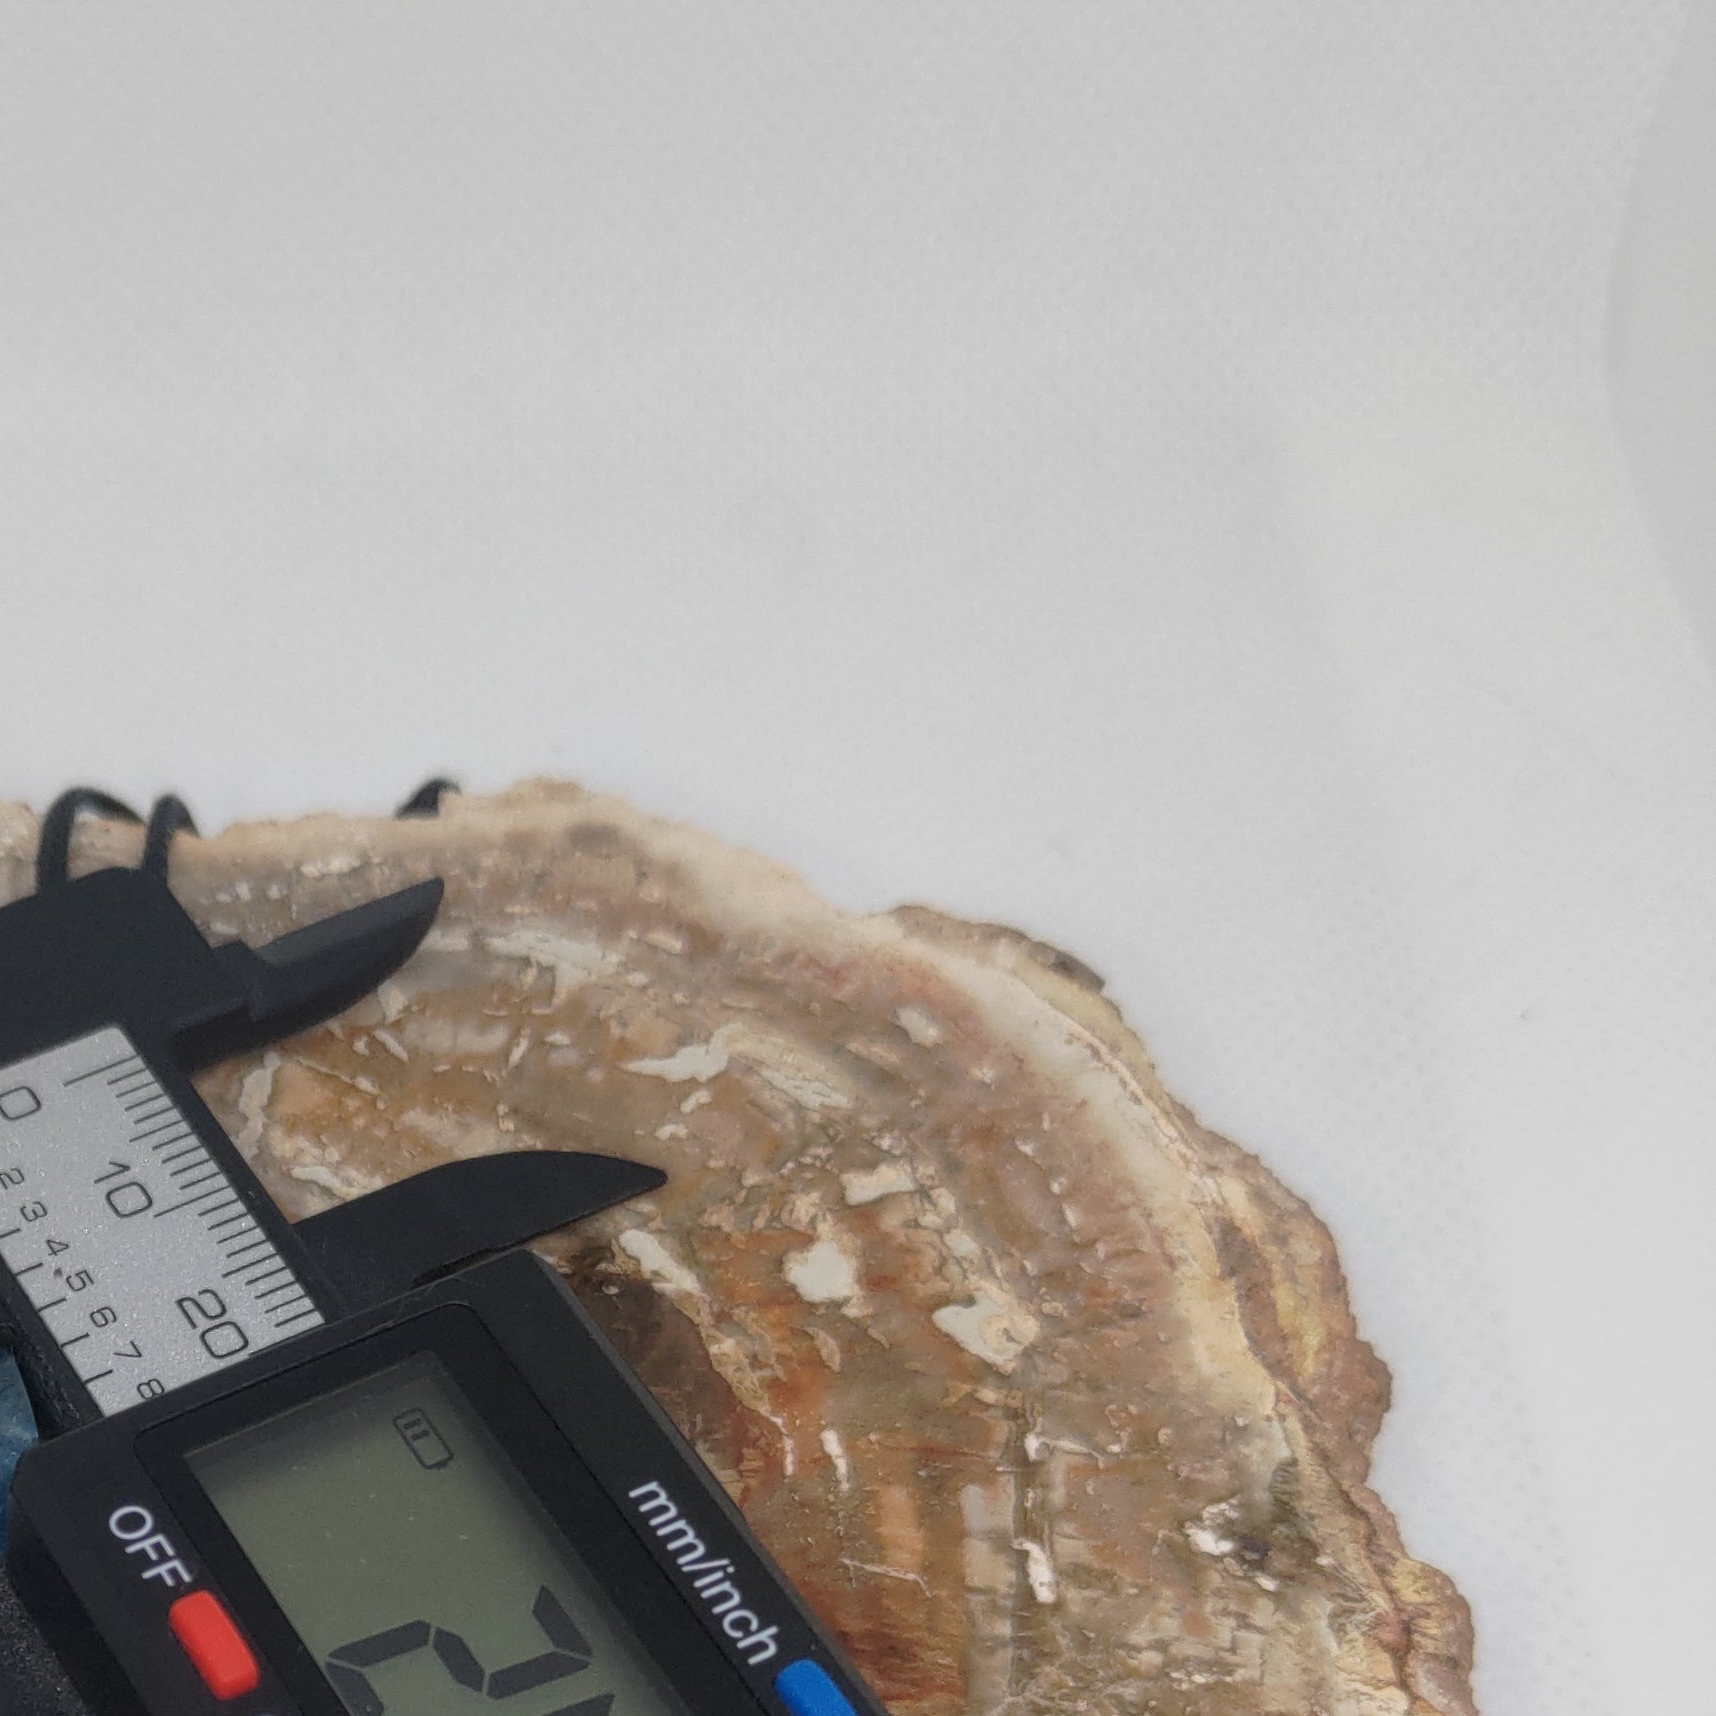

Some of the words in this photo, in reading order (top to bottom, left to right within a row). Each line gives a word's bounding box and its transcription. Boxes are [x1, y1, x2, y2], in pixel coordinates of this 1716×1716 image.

[94, 1161, 153, 1218] 10
[20, 1201, 48, 1223] 3
[45, 1238, 69, 1257] 4
[66, 1269, 95, 1293] 5
[90, 1306, 118, 1329] 6
[175, 1288, 249, 1359] 20
[113, 1341, 143, 1362] 7
[137, 1377, 166, 1400] 8
[108, 1504, 193, 1589] OFF
[628, 1479, 780, 1667] mm/inch
